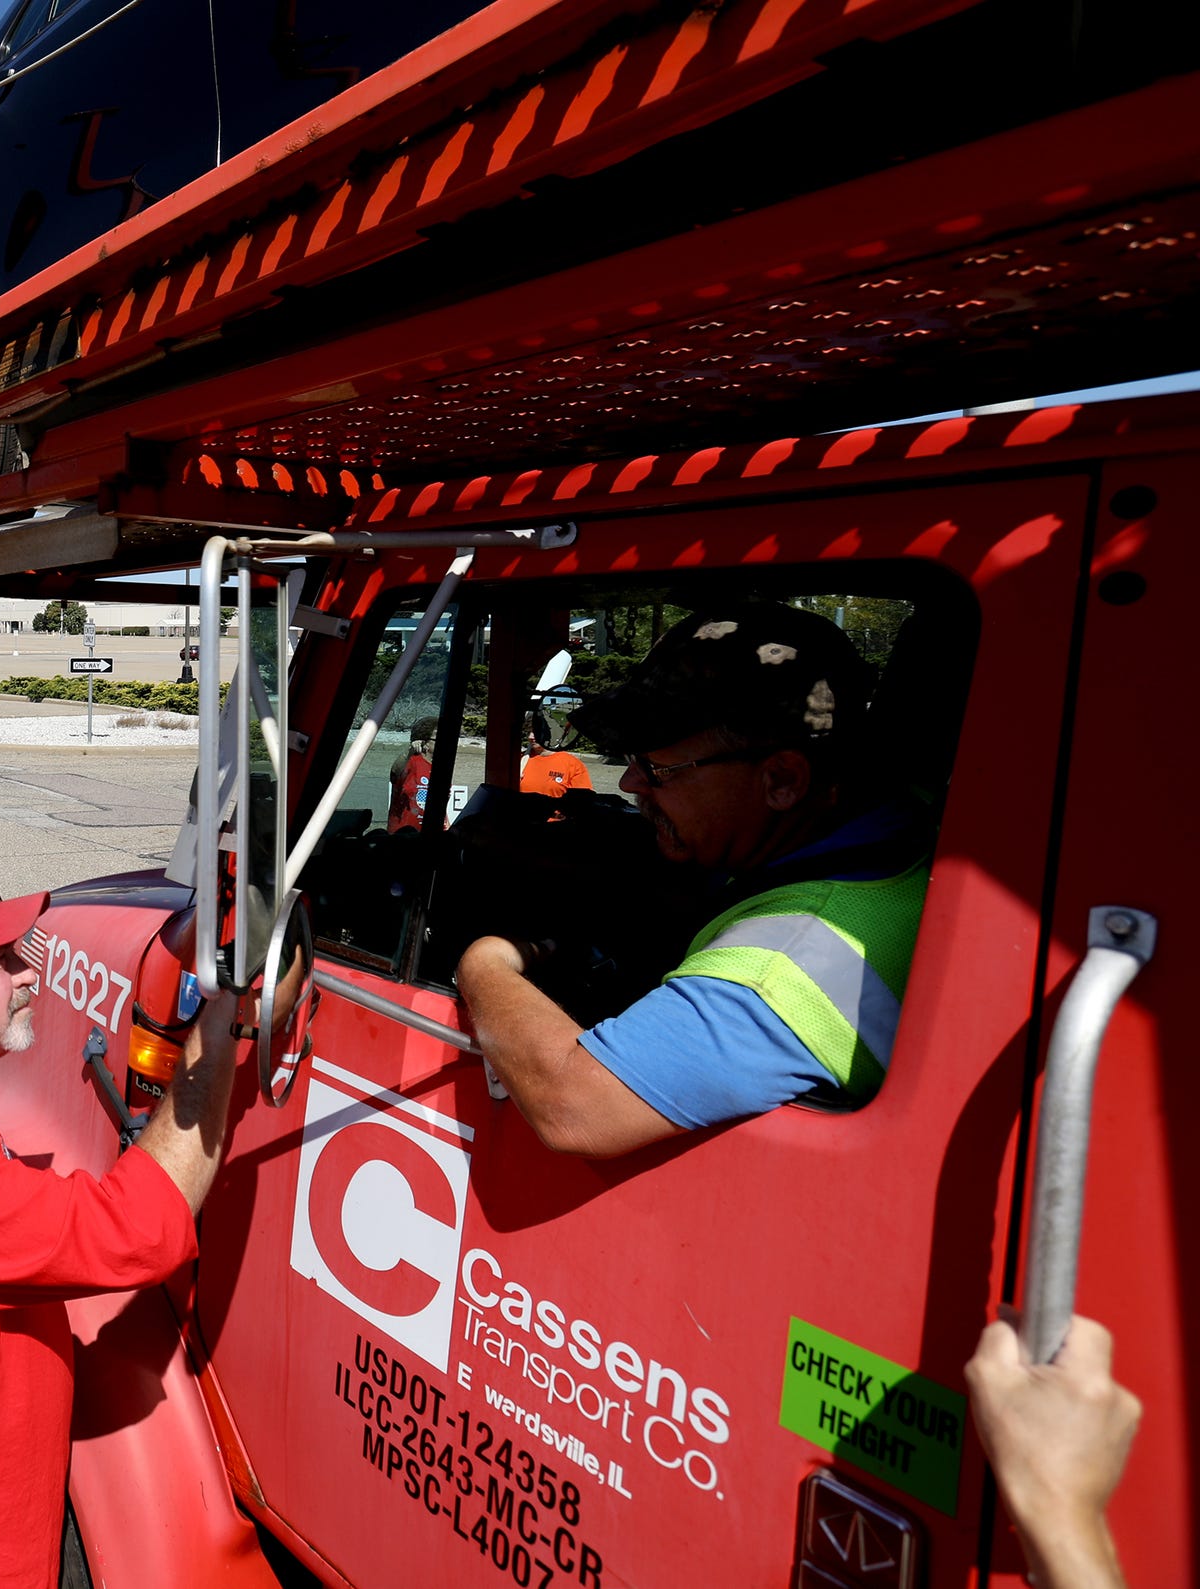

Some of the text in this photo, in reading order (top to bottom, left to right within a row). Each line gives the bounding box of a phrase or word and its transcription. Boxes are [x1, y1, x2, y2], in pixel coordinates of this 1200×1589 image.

[45, 934, 132, 1034] 12627
[135, 1075, 165, 1100] Lo-Pr
[458, 1297, 724, 1500] Transport Co.
[462, 1248, 730, 1444] Cassens
[791, 1340, 959, 1449] CHECK YOUR
[335, 1361, 603, 1589] ILCC-2643-MC-CR
[355, 1334, 581, 1526] USDOT-124358
[608, 1461, 632, 1499] IL
[819, 1399, 917, 1473] HEIGHT
[362, 1424, 554, 1589] MPSC-L4007
